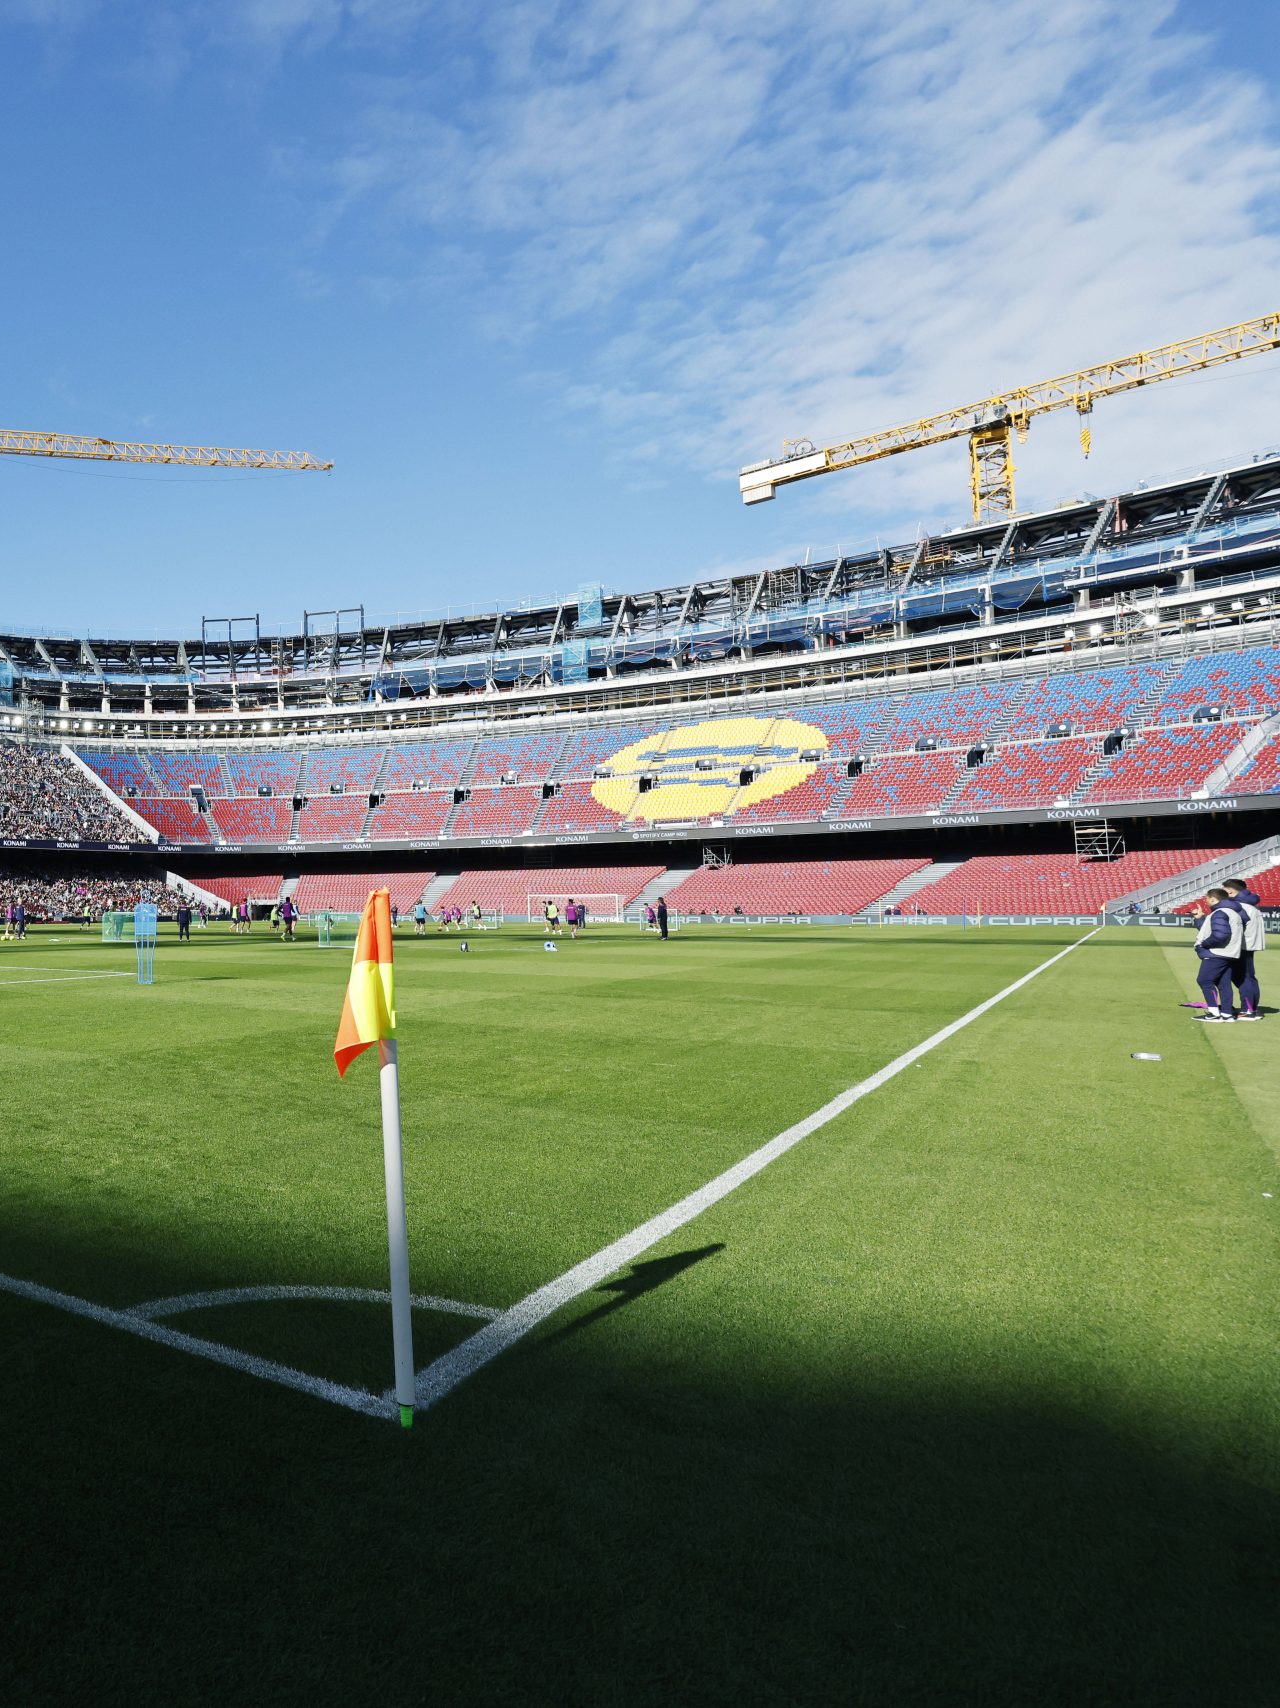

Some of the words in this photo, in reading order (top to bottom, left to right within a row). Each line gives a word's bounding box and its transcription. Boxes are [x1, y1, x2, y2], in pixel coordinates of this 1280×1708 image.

[1176, 799, 1238, 811] KONAMI
[1046, 808, 1100, 819] KONAMI
[931, 814, 979, 825] KONAMI
[828, 820, 872, 830] KONAMI
[480, 839, 513, 847] KONAMI
[555, 836, 589, 844] KONAMI
[343, 842, 371, 851] KONAMI
[410, 841, 439, 849] KONAMI
[730, 916, 811, 924] CUPRA
[852, 917, 948, 925] CUPRA
[989, 917, 1098, 926] CUPRA
[1138, 916, 1195, 926] CUP
